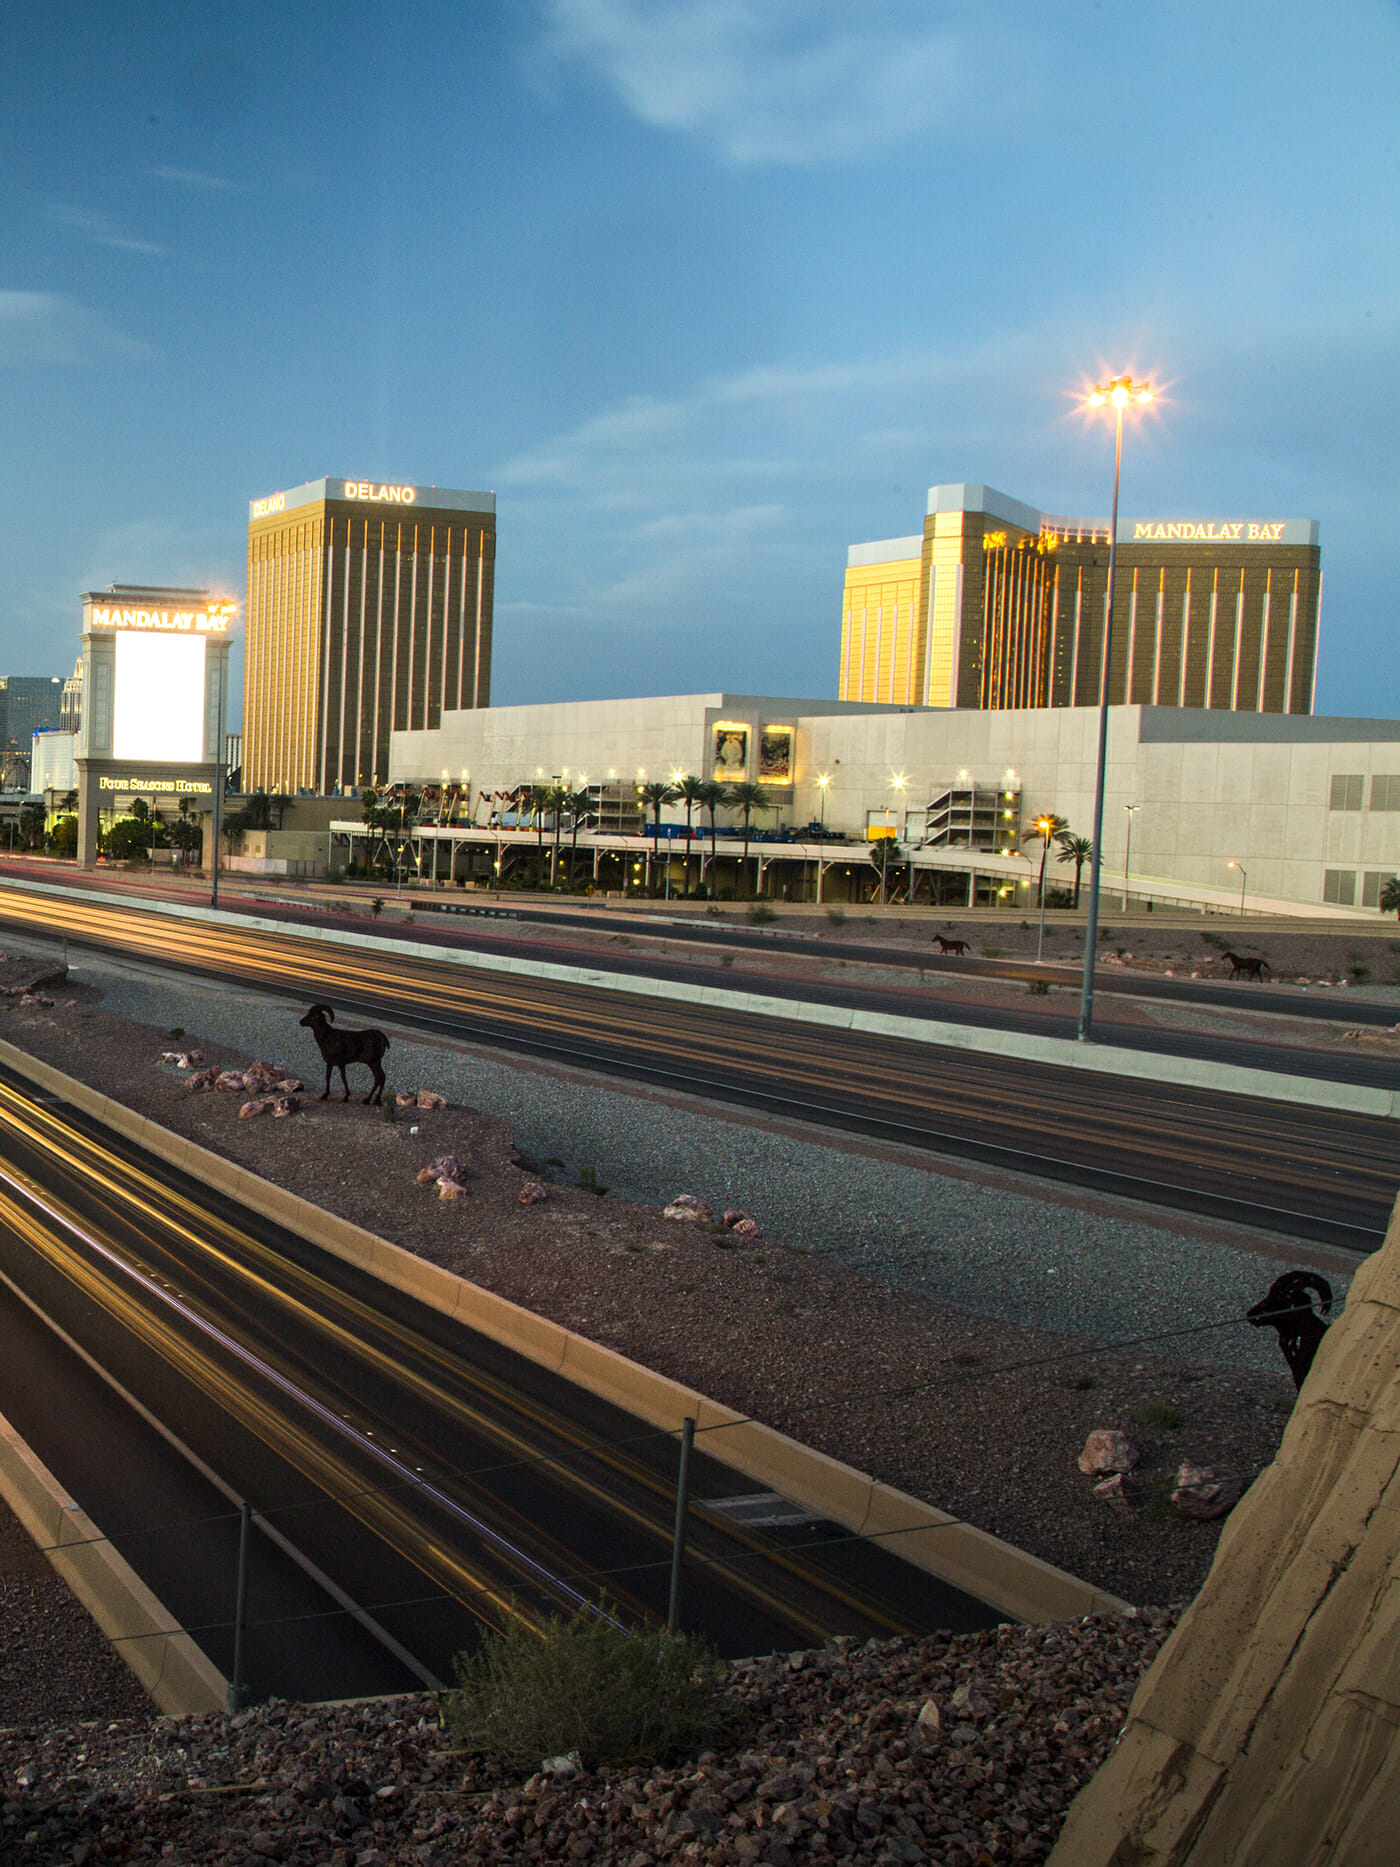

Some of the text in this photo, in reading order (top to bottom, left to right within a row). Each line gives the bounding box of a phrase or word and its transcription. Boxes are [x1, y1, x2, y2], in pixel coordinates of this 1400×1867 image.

[345, 482, 414, 503] DELANO
[253, 494, 286, 518] DELANO
[1133, 523, 1286, 540] MANDALAY BAY
[92, 608, 230, 631] MANDALAY BAY
[99, 777, 213, 793] FOUR SEASONS HOTEL
